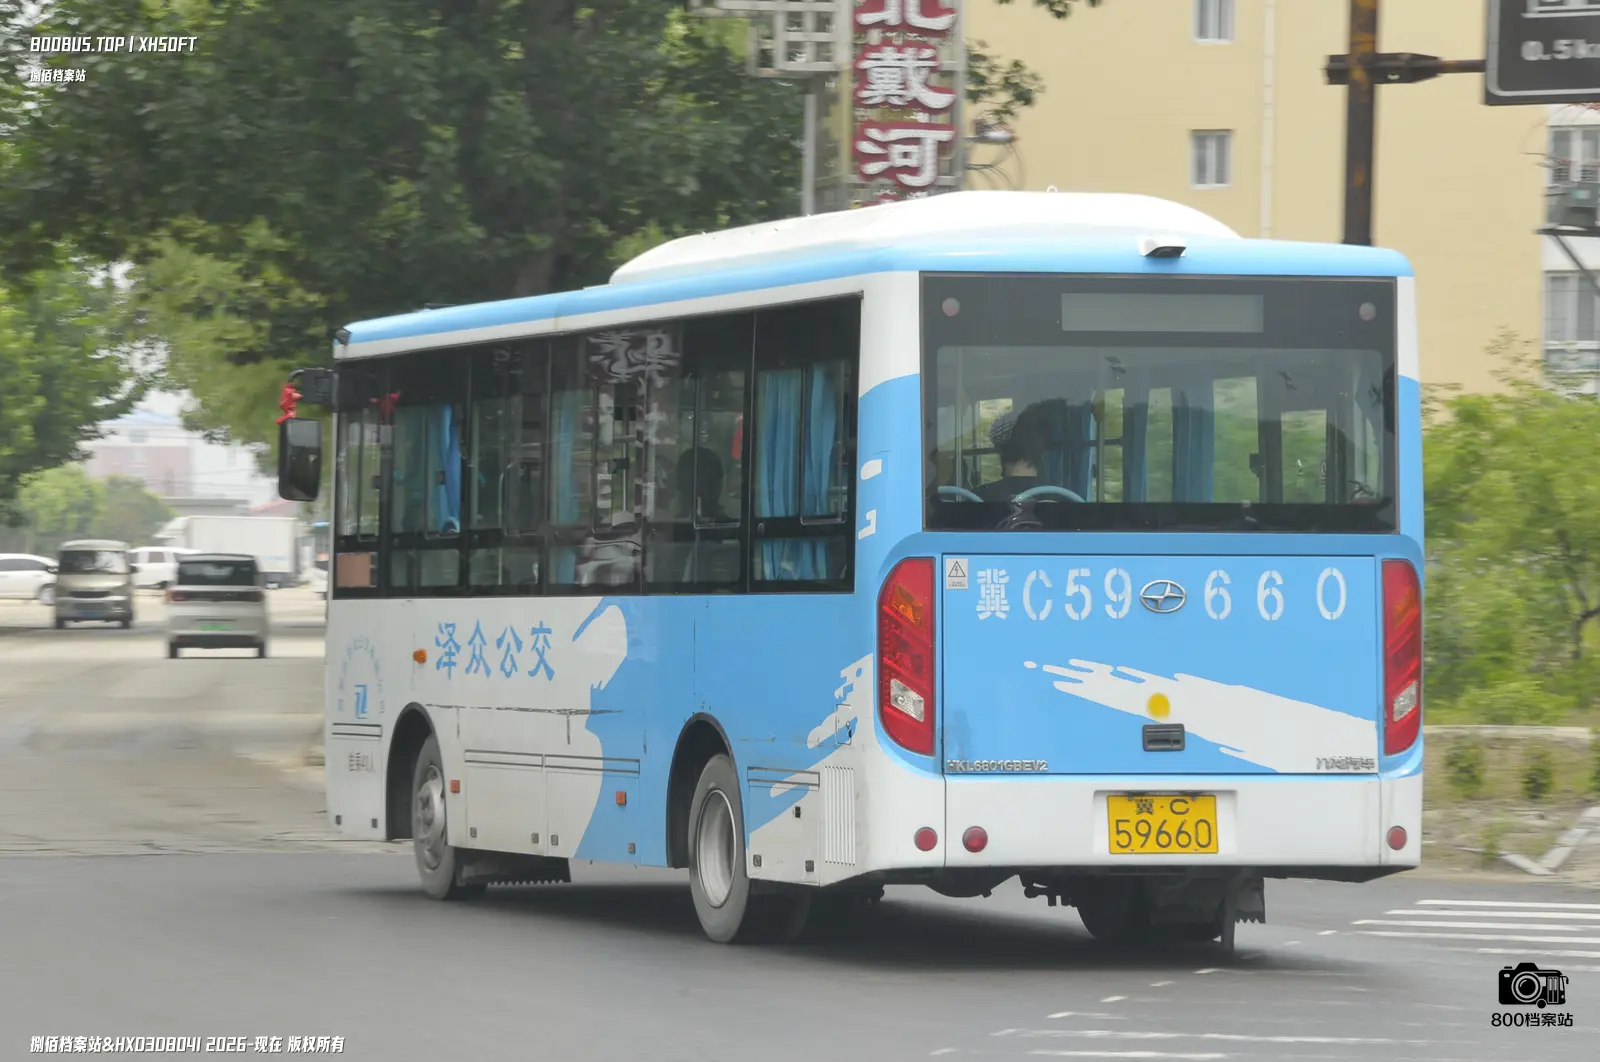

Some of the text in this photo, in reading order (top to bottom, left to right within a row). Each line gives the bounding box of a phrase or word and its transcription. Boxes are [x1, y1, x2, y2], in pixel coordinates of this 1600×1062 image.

[435, 619, 555, 681] 泽众公交
[1115, 818, 1212, 849] 59660
